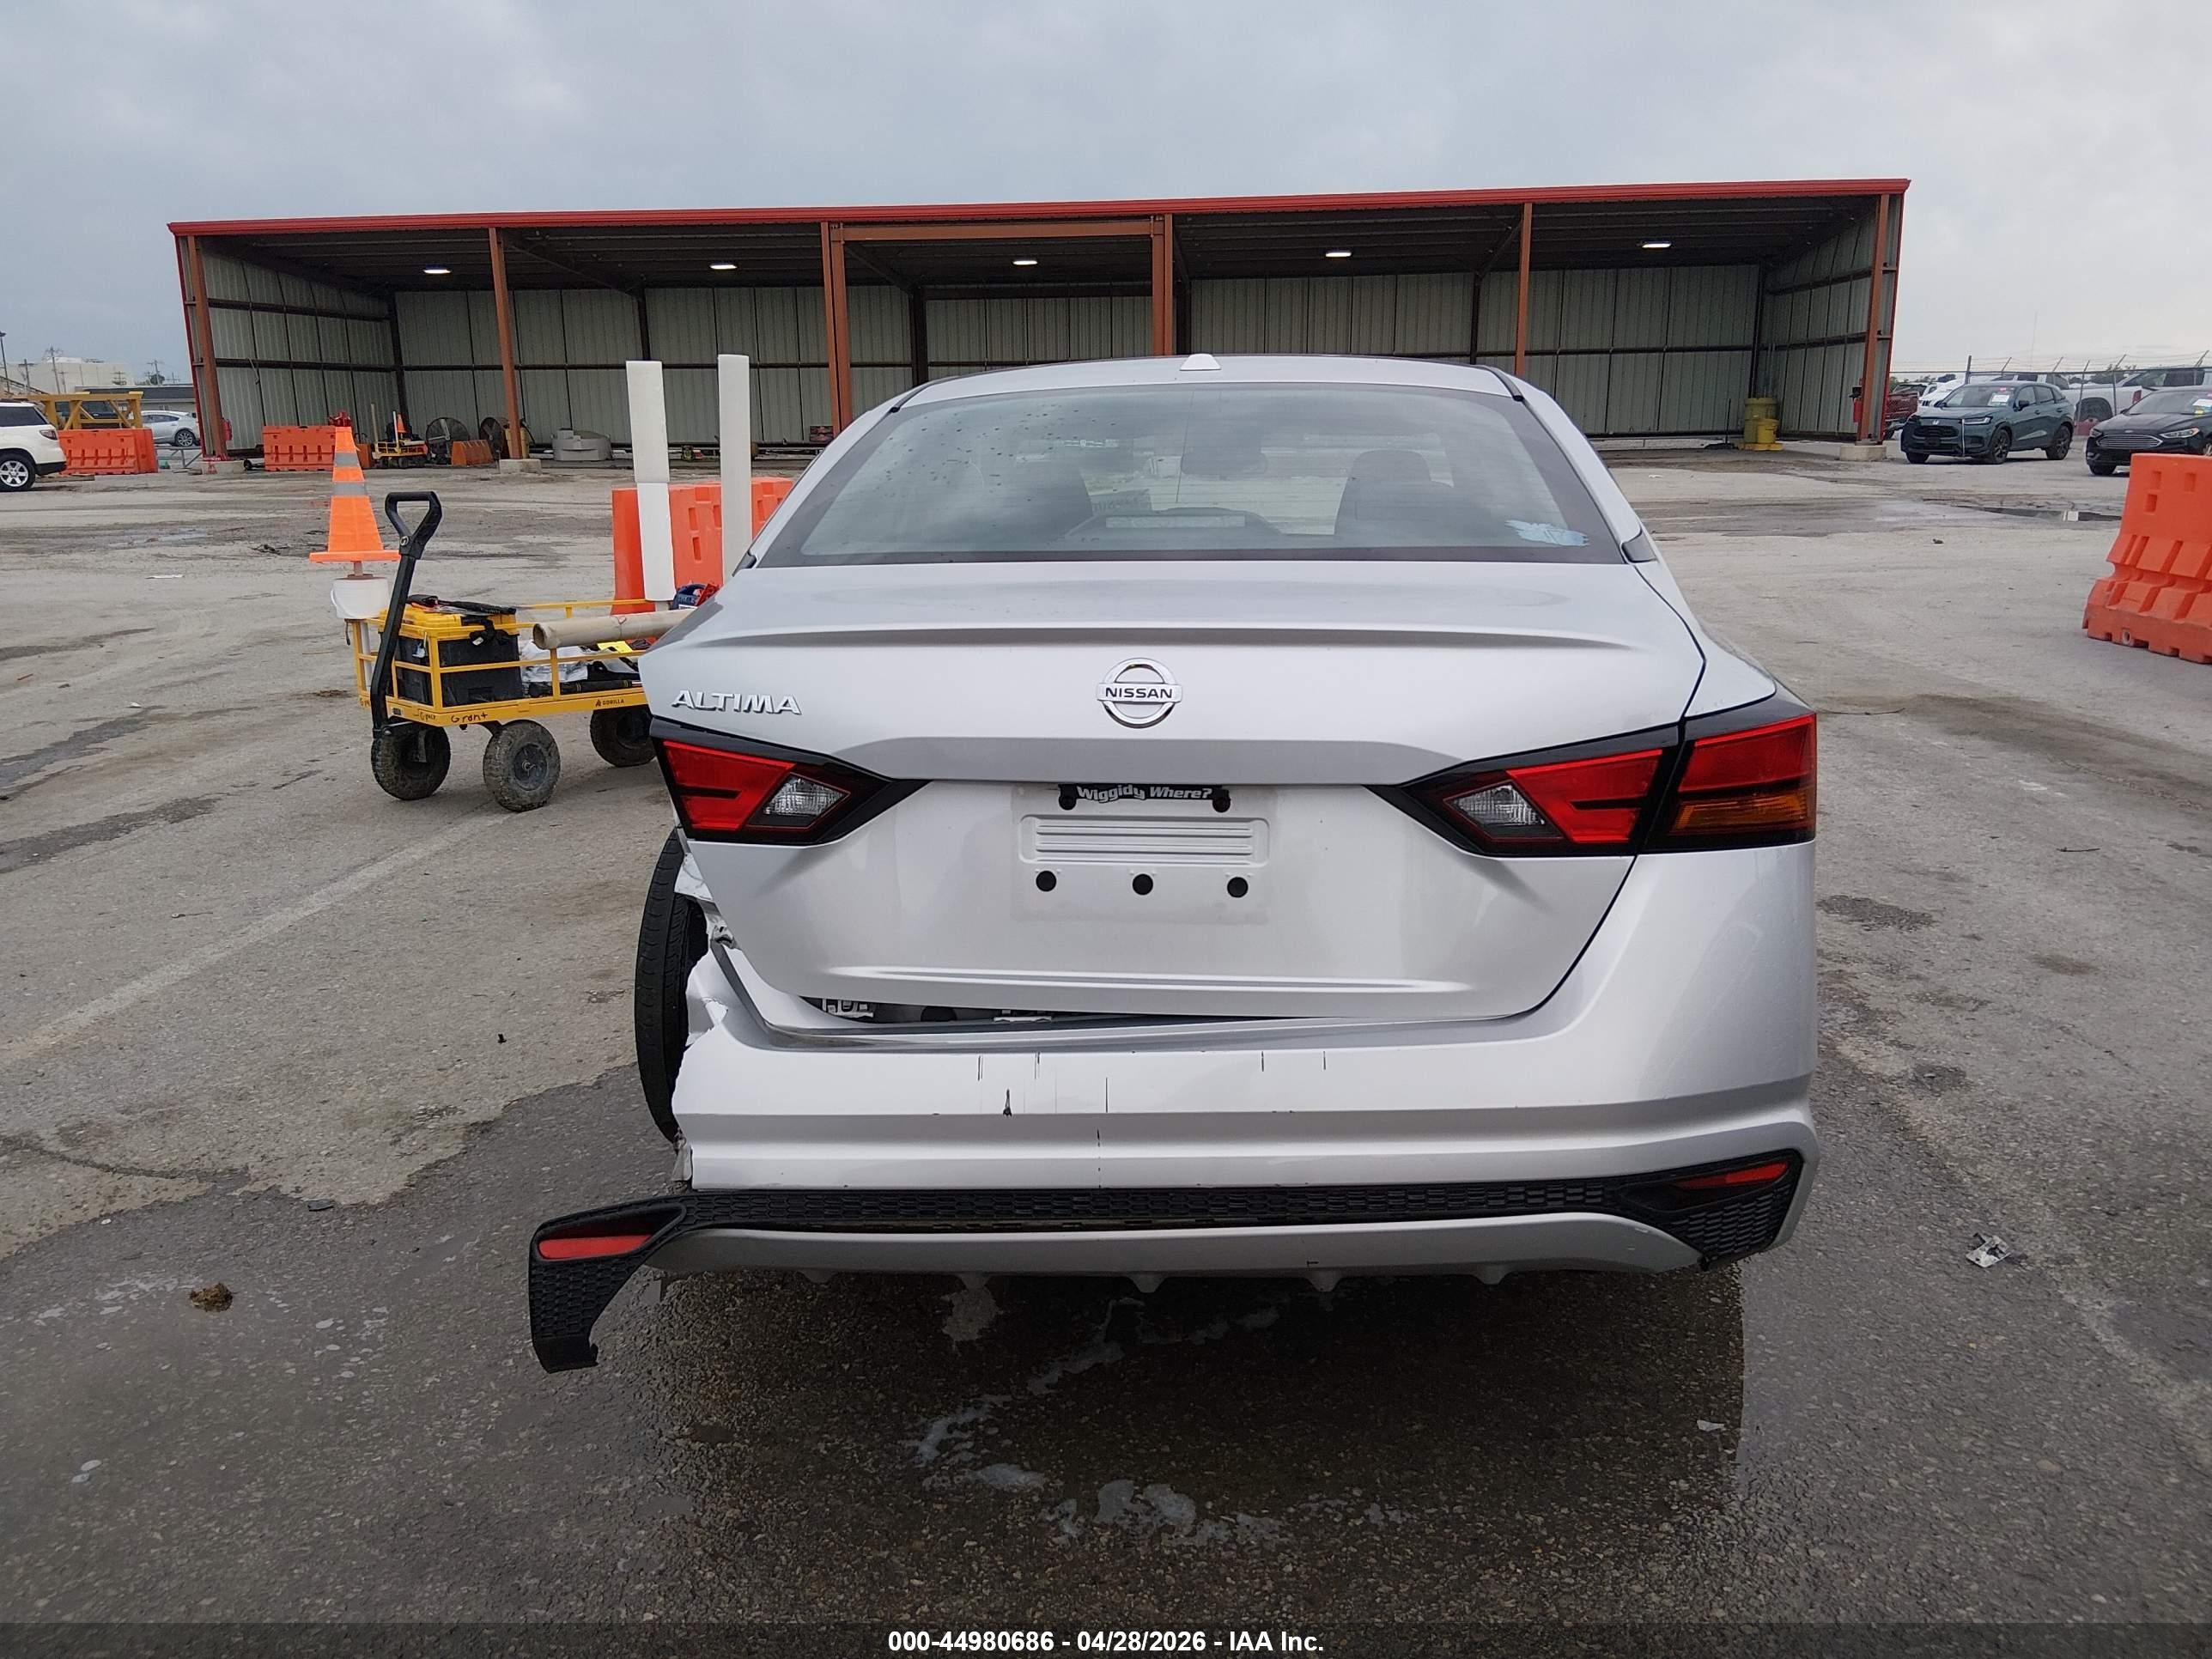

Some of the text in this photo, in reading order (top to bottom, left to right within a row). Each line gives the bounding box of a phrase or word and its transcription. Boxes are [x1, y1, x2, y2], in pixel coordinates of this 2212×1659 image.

[1104, 687, 1173, 699] NISSAN
[602, 698, 625, 707] GORILLA
[671, 690, 802, 715] ALTIMA
[450, 711, 489, 724] Grant
[1077, 784, 1212, 804] Wiggidy Where?
